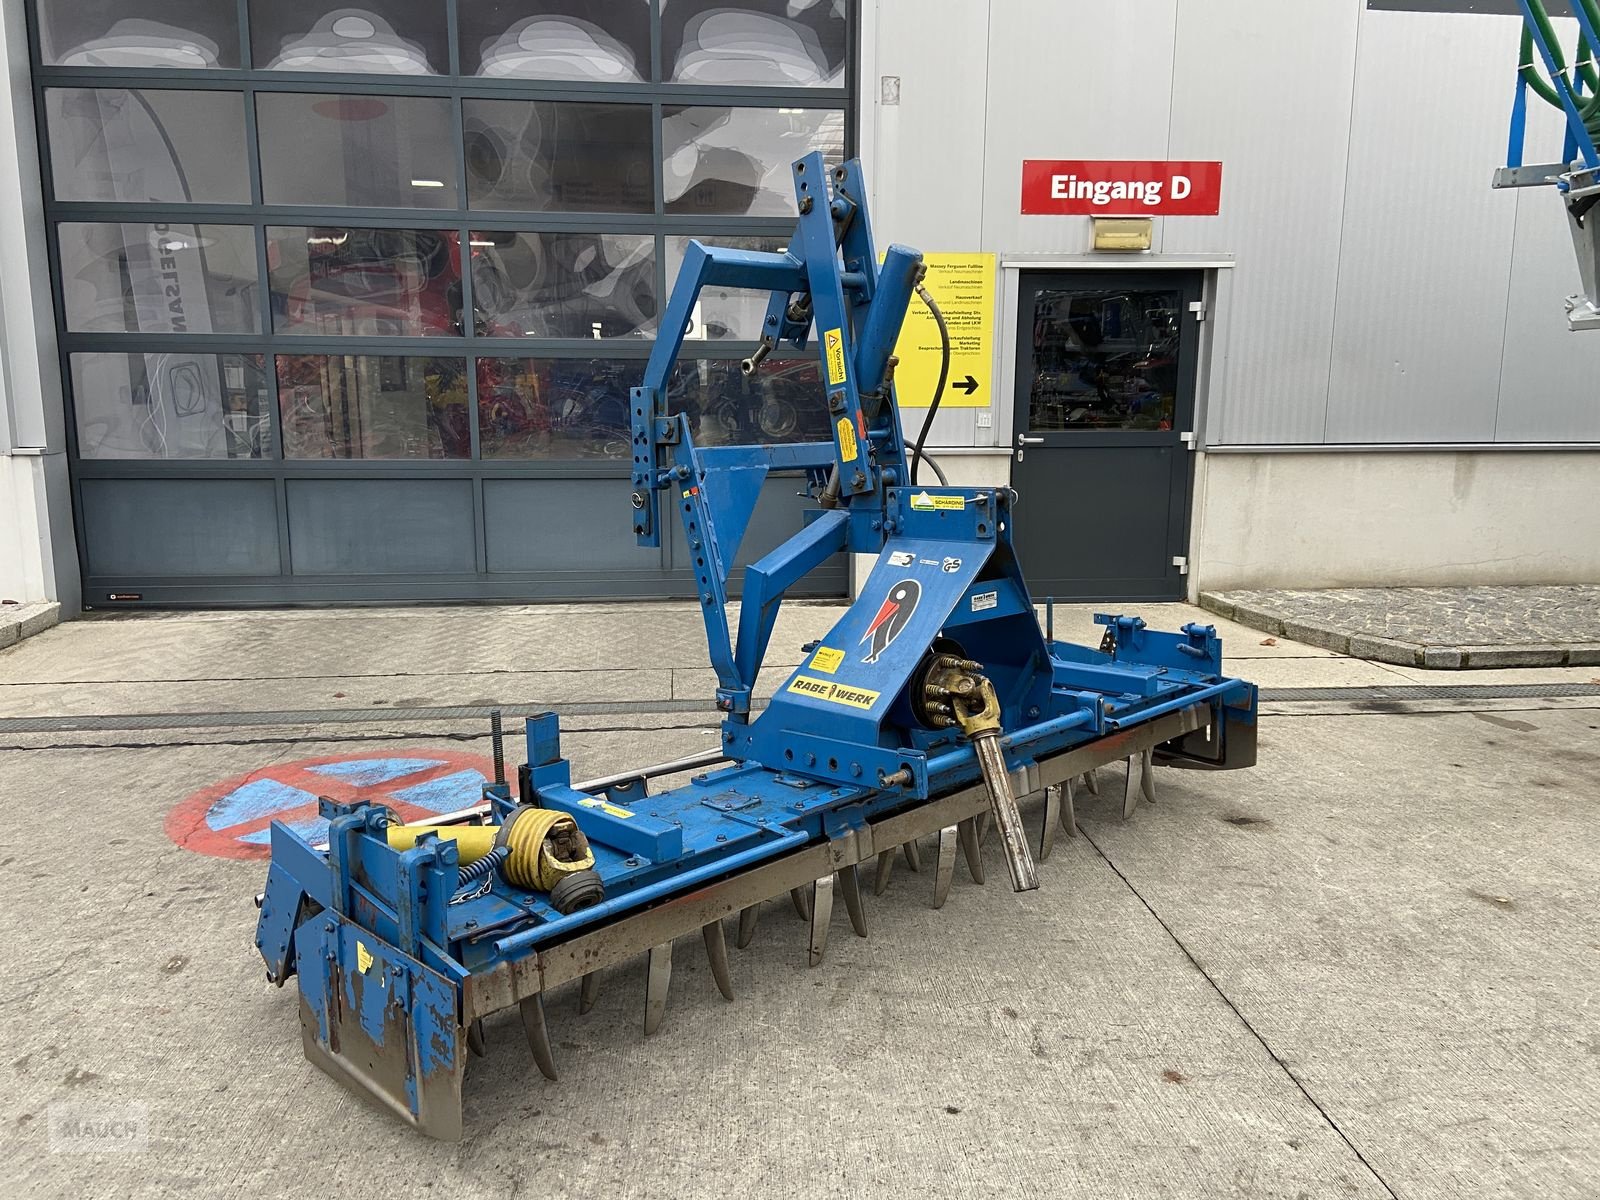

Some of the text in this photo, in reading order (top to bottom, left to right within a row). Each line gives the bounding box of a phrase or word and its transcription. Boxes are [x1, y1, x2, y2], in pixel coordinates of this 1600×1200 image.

[1051, 174, 1191, 205] Eingang D
[836, 347, 844, 380] Vorsicht
[943, 559, 960, 572] GS
[793, 680, 875, 705] RABE WERK
